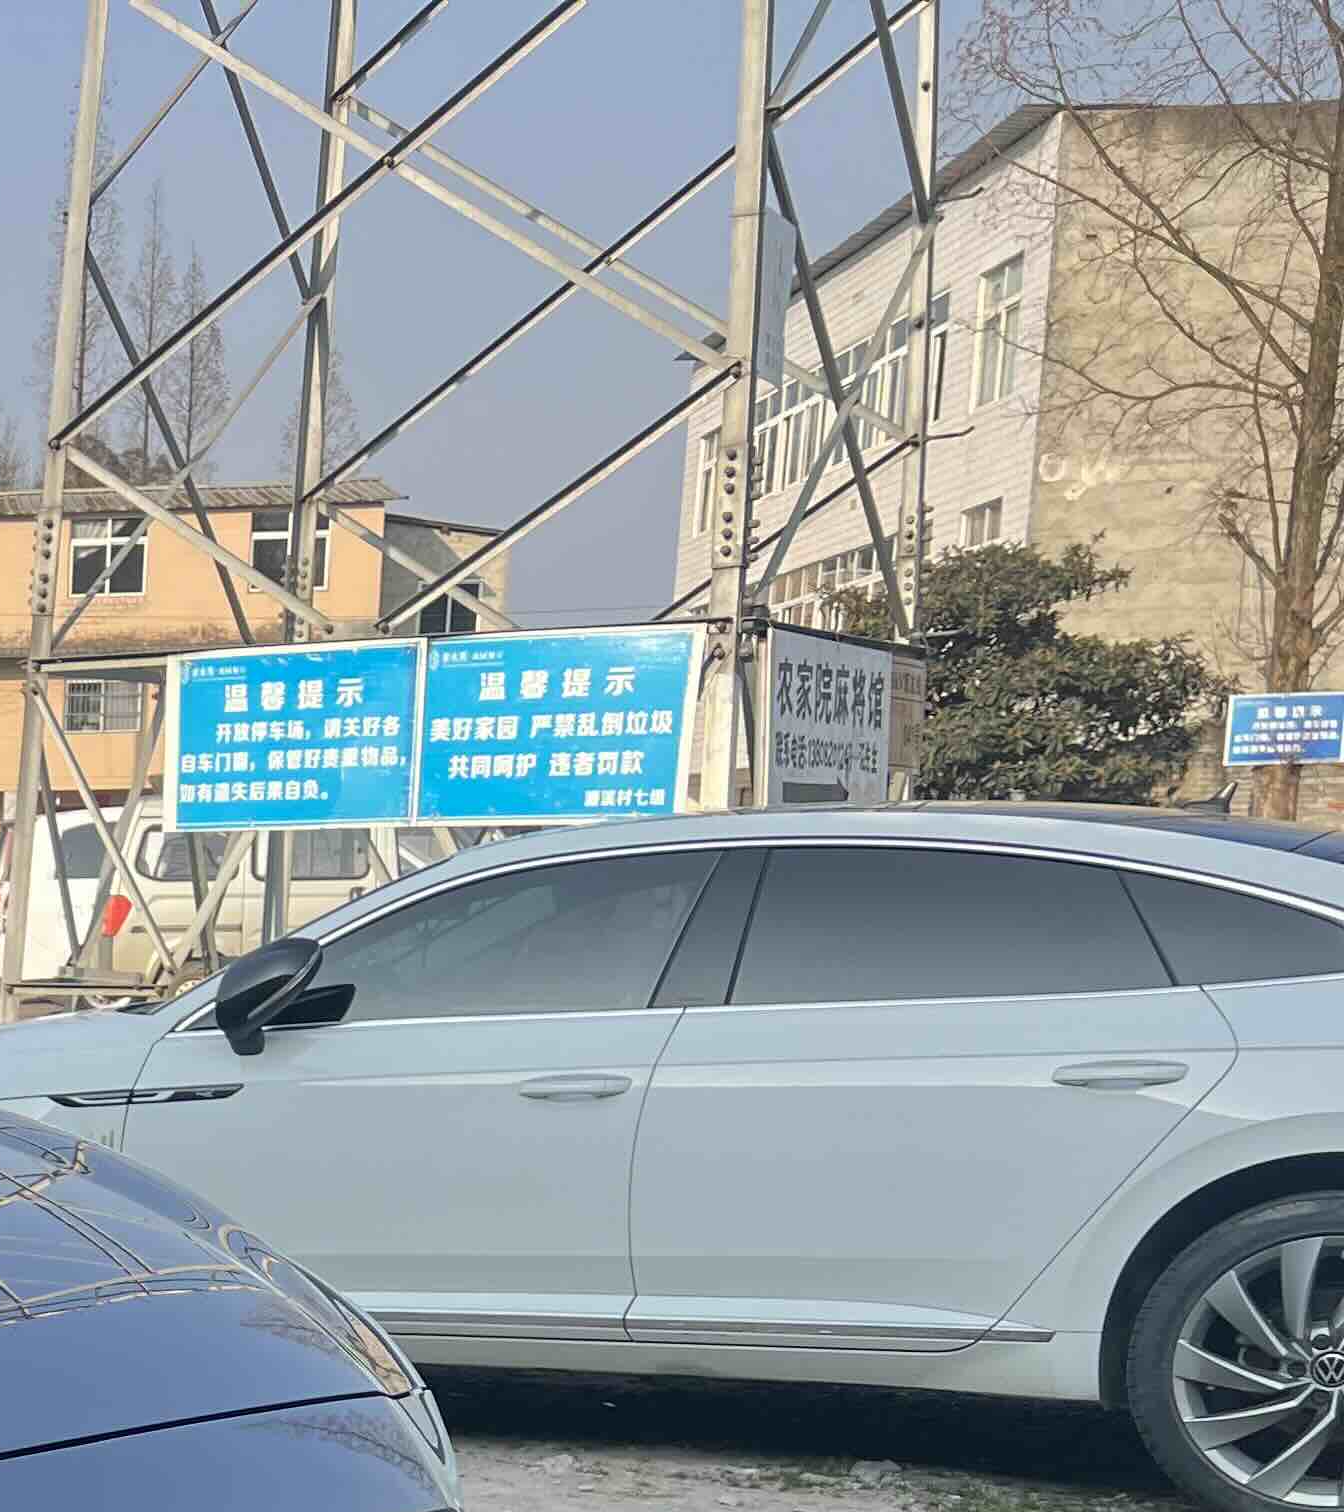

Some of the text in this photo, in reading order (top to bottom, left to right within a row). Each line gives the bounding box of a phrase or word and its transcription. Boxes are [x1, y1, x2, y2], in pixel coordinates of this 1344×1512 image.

[223, 677, 365, 713] 温馨提示
[478, 666, 636, 701] 温馨提示
[777, 657, 886, 729] 农家院麻将馆
[429, 710, 673, 742] 美好家园 严禁乱倒垃圾
[448, 753, 537, 780] 共同呵护
